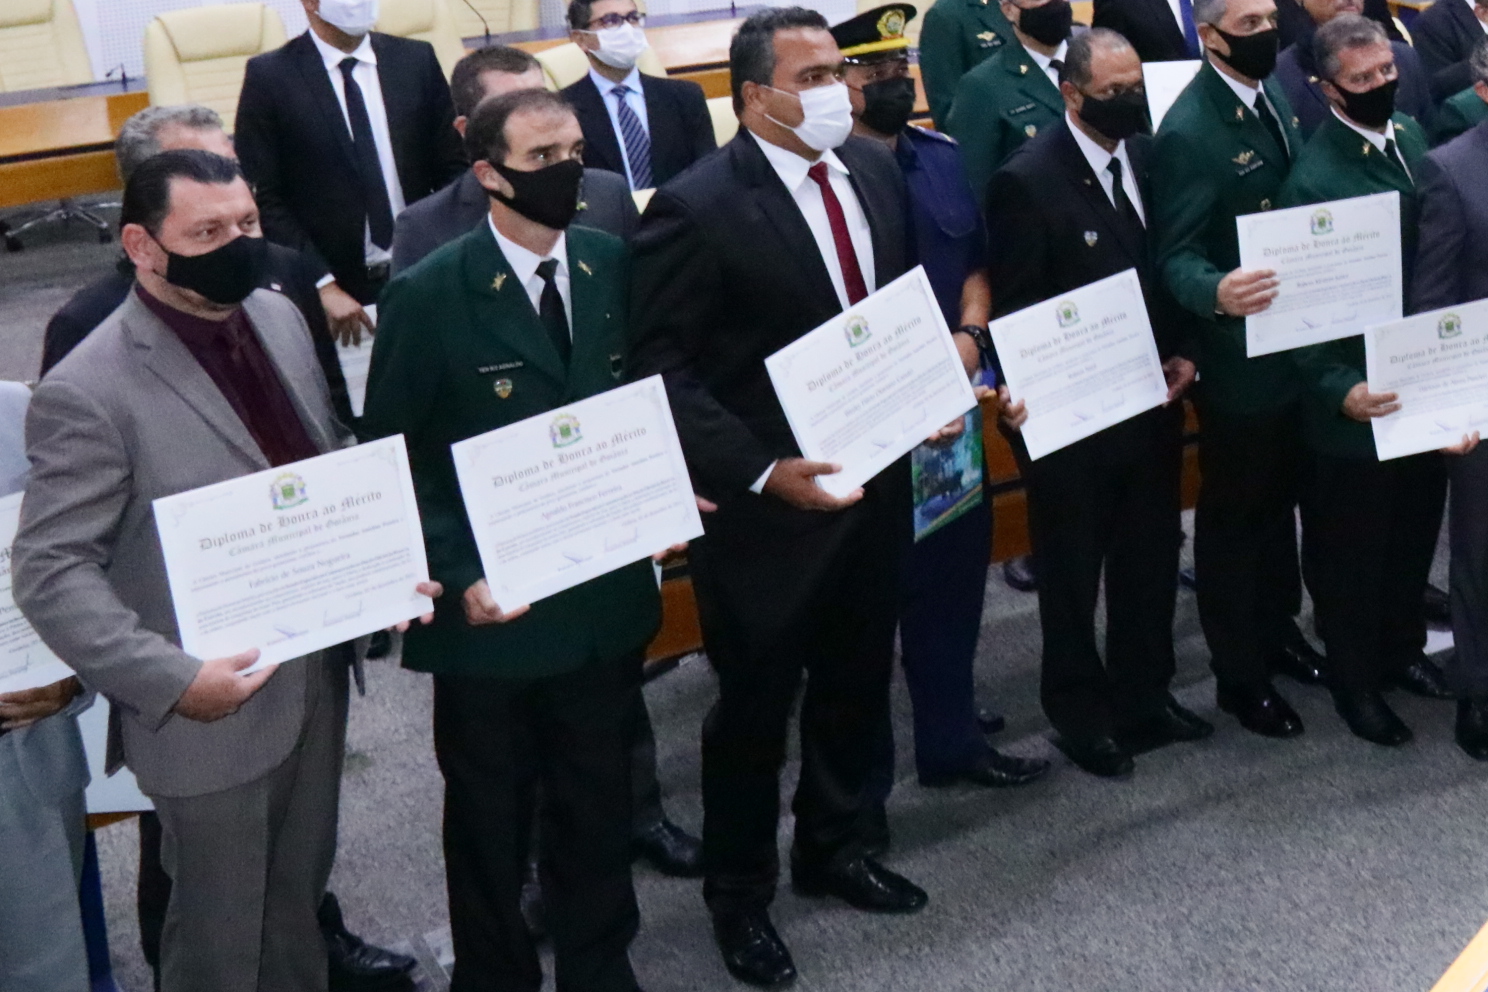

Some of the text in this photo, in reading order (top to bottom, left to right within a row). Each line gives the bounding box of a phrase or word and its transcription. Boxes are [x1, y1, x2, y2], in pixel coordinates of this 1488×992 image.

[491, 465, 540, 489] Diploma
[542, 458, 554, 470] de
[595, 442, 608, 452] ao
[611, 427, 647, 447] Mérito
[198, 528, 256, 552] Diploma
[259, 520, 273, 534] de
[322, 505, 337, 517] ao
[341, 491, 383, 510] Mérito
